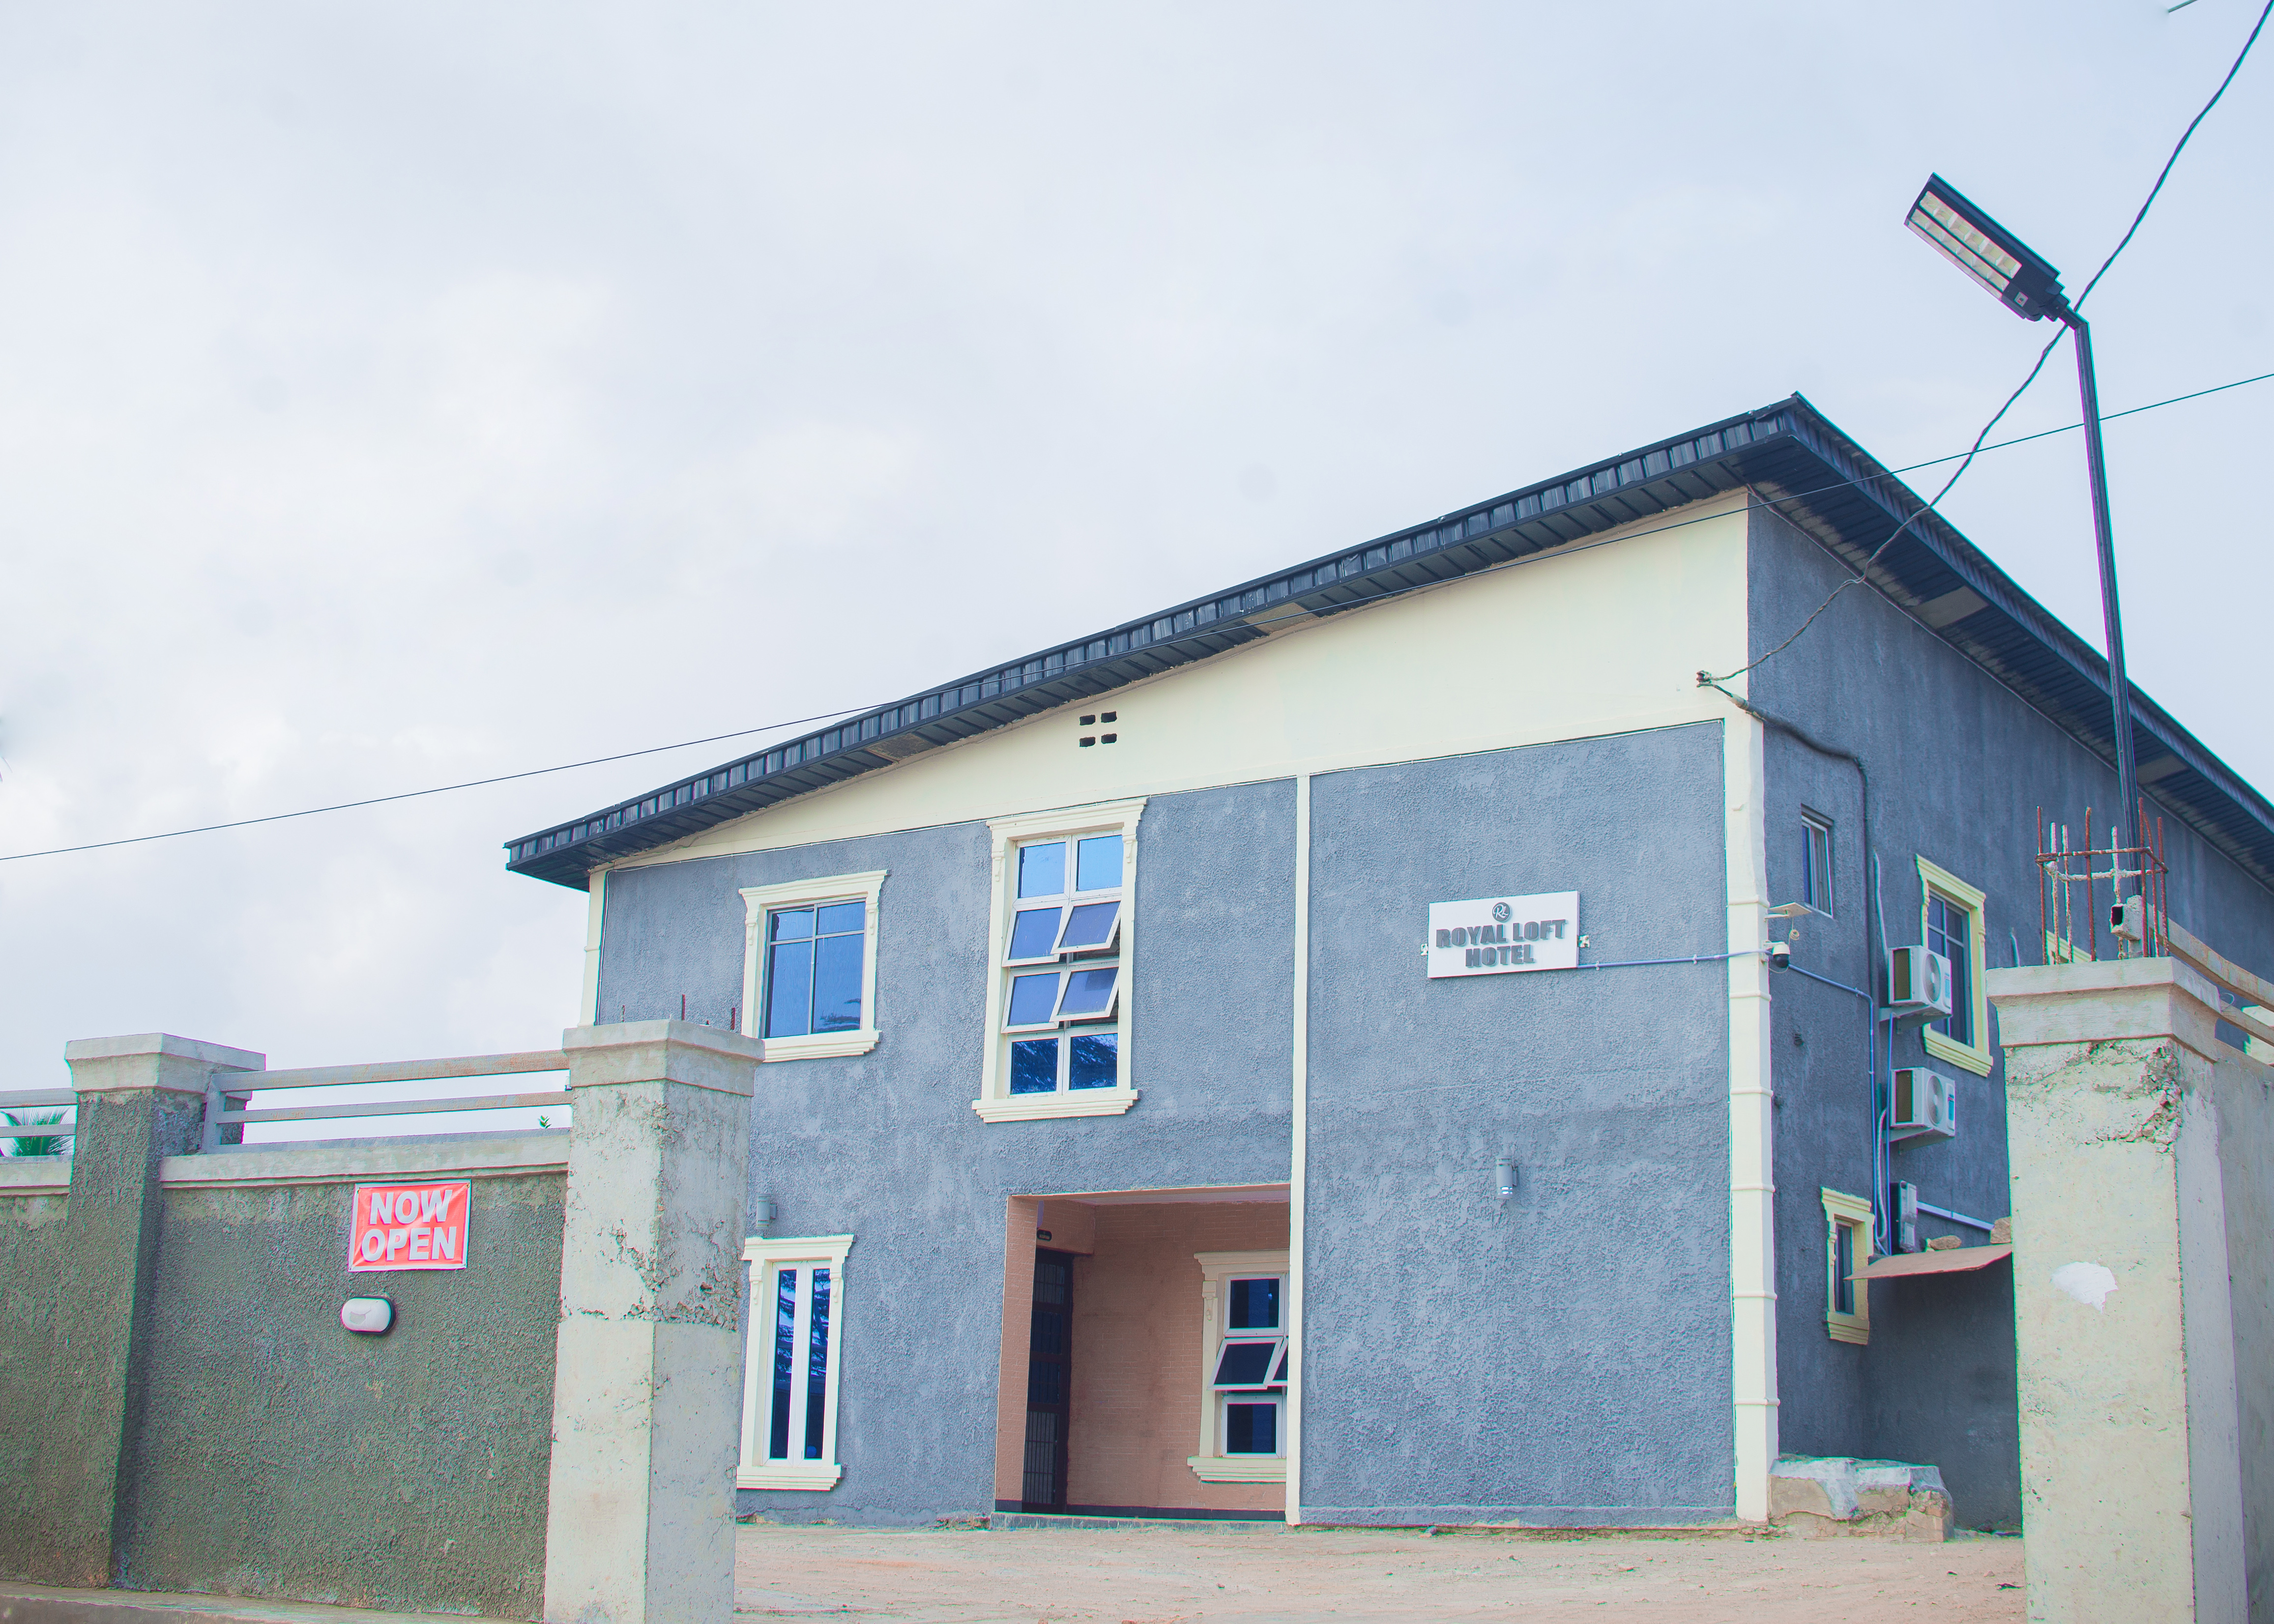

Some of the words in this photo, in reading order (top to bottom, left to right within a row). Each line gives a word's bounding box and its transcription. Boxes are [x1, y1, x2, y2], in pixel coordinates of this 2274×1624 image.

[1436, 924, 1507, 948] ROYAL
[1513, 919, 1566, 941] LOFT
[1465, 944, 1534, 967] HOTEL
[369, 1189, 453, 1224] NOW
[360, 1226, 457, 1261] OPEN
